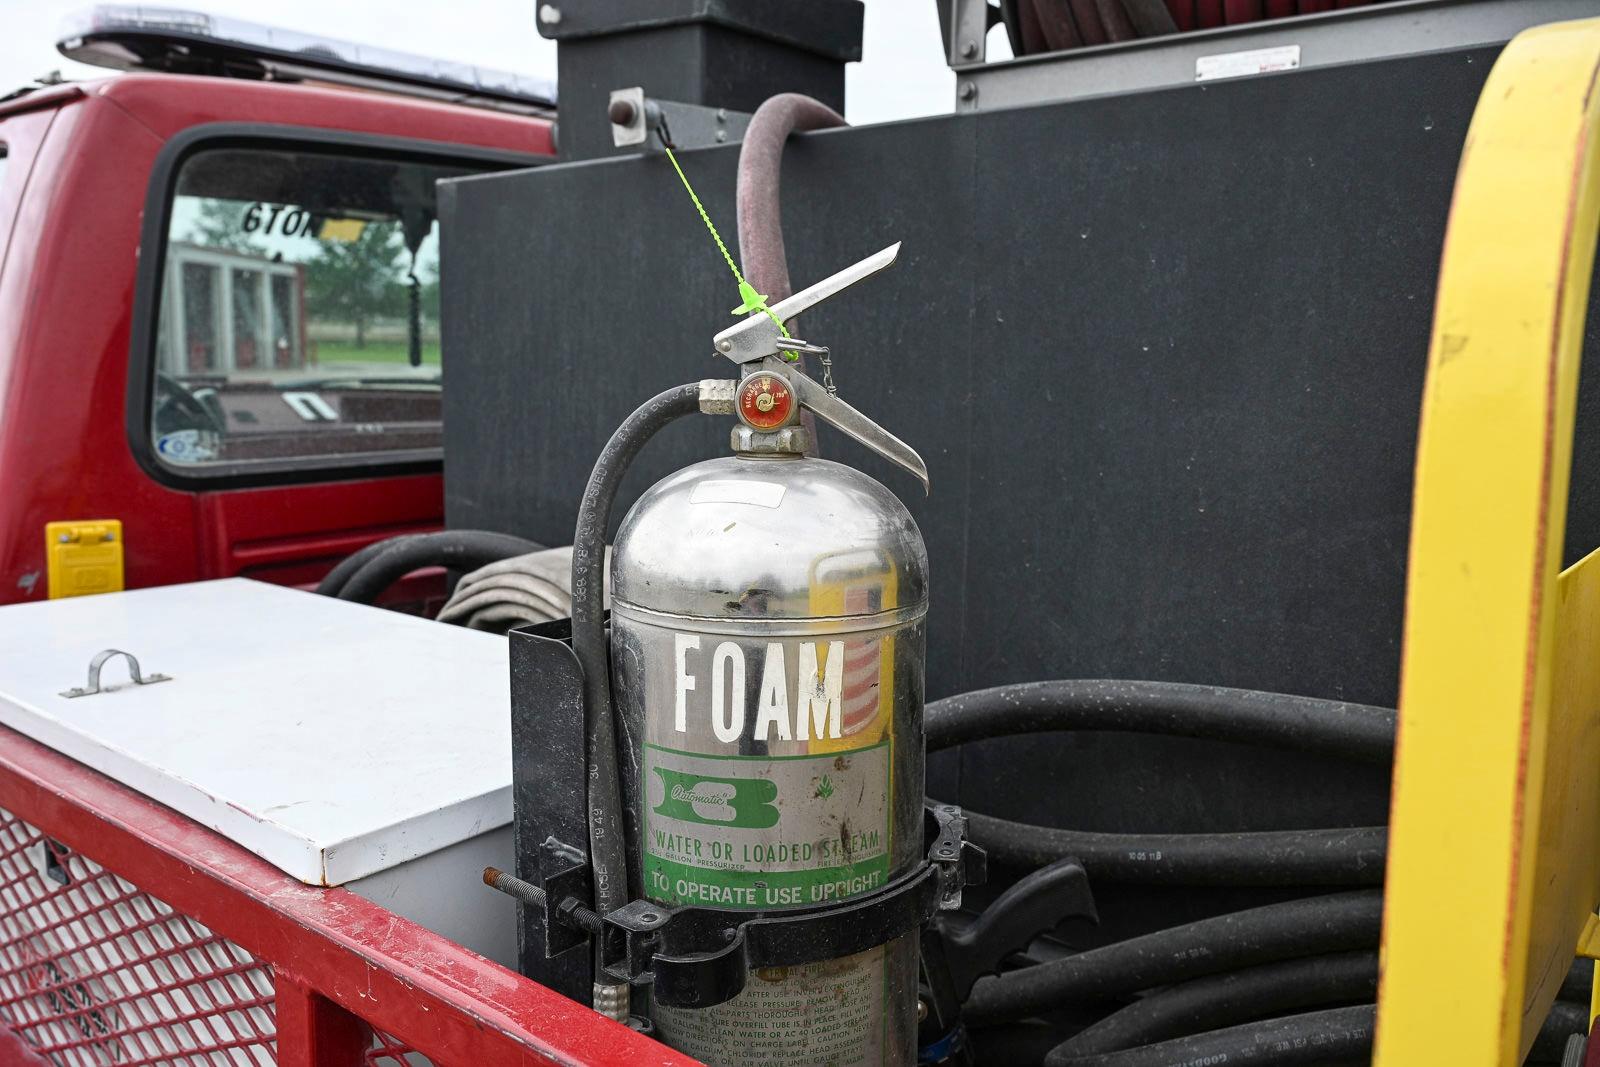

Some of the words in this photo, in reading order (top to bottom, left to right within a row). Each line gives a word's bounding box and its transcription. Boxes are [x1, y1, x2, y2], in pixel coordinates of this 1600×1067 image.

[674, 633, 845, 743] FOAM
[655, 829, 702, 857] WATER
[711, 841, 733, 861] OR
[744, 843, 812, 862] LOADED
[823, 829, 880, 858] STEAM
[697, 859, 745, 870] PRESSURIZED
[651, 870, 670, 892] TO
[676, 879, 757, 905] OPERATE
[766, 886, 802, 905] USE
[811, 870, 881, 902] UPRIGHT
[746, 991, 770, 999] AFTER
[726, 999, 758, 1008] RELEASE
[726, 1009, 751, 1018] PARTS
[711, 1019, 730, 1027] SURE
[732, 1021, 769, 1029] OVERFILL
[770, 1021, 790, 1029] TUBE
[803, 1019, 812, 1027] IN
[739, 1031, 767, 1039] WATER
[769, 1031, 781, 1039] OR
[784, 1030, 796, 1038] AC
[811, 1022, 841, 1035] LOADED
[844, 1013, 869, 1028] STREAM
[772, 1049, 806, 1059] REPLACE
[810, 1045, 830, 1055] HEAD
